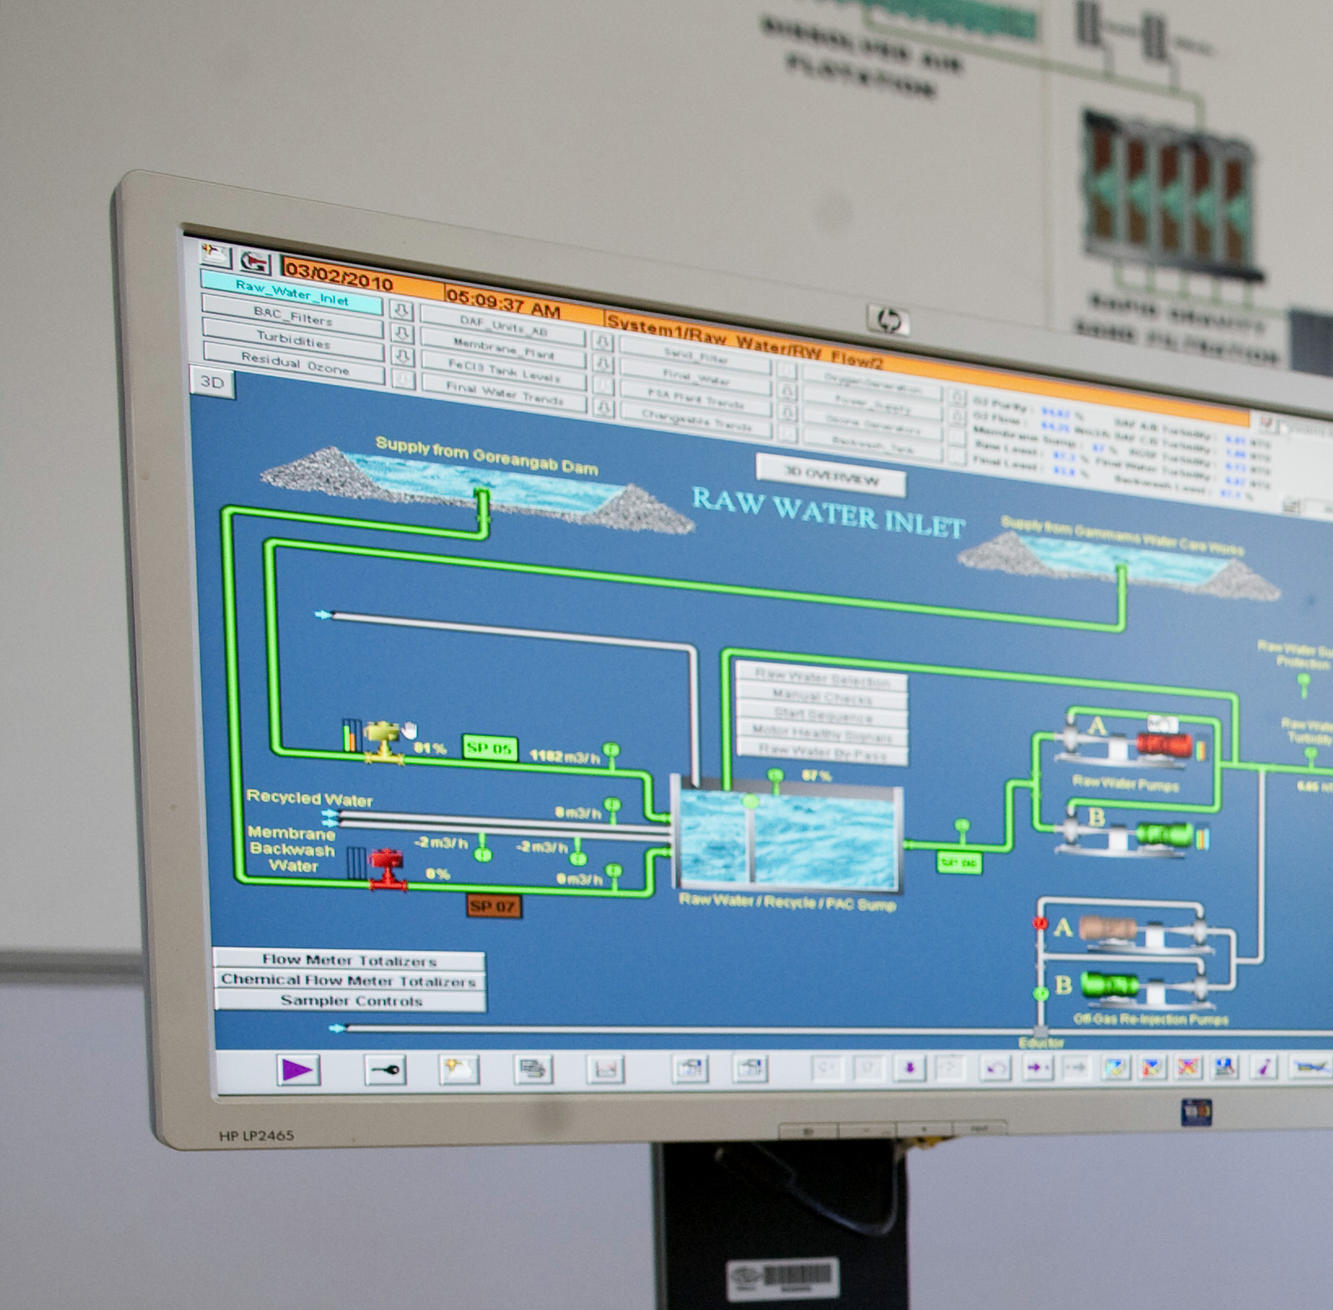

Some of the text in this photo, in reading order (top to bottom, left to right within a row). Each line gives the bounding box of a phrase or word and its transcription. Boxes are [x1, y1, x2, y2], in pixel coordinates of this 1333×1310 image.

[285, 262, 393, 291] 03/02/2010
[236, 280, 349, 306] Raw_Water_Inlet
[446, 289, 561, 320] 05:09:37 AM
[254, 306, 332, 327] BAC_Filters
[257, 330, 331, 349] Turbidities
[241, 352, 350, 377] Residual Ozone
[200, 375, 224, 388] 3D
[376, 436, 599, 476] Supply from Goreangab Dam
[692, 486, 967, 539] RAW WATER INLET
[1088, 716, 1107, 735] A
[467, 743, 512, 757] SP 05
[247, 789, 374, 808] Recycled Water
[1088, 807, 1106, 827] B
[247, 825, 336, 842] Membrane
[250, 842, 335, 858] Backwash
[269, 858, 319, 873] Water
[1053, 918, 1073, 937] A
[262, 953, 437, 968] Flow Meter Totalizers
[221, 973, 477, 989] Chemical Flow Meter Totalizers
[1055, 975, 1073, 994] B
[281, 994, 423, 1008] Sampler Controls
[219, 1130, 294, 1143] HP LP2465
